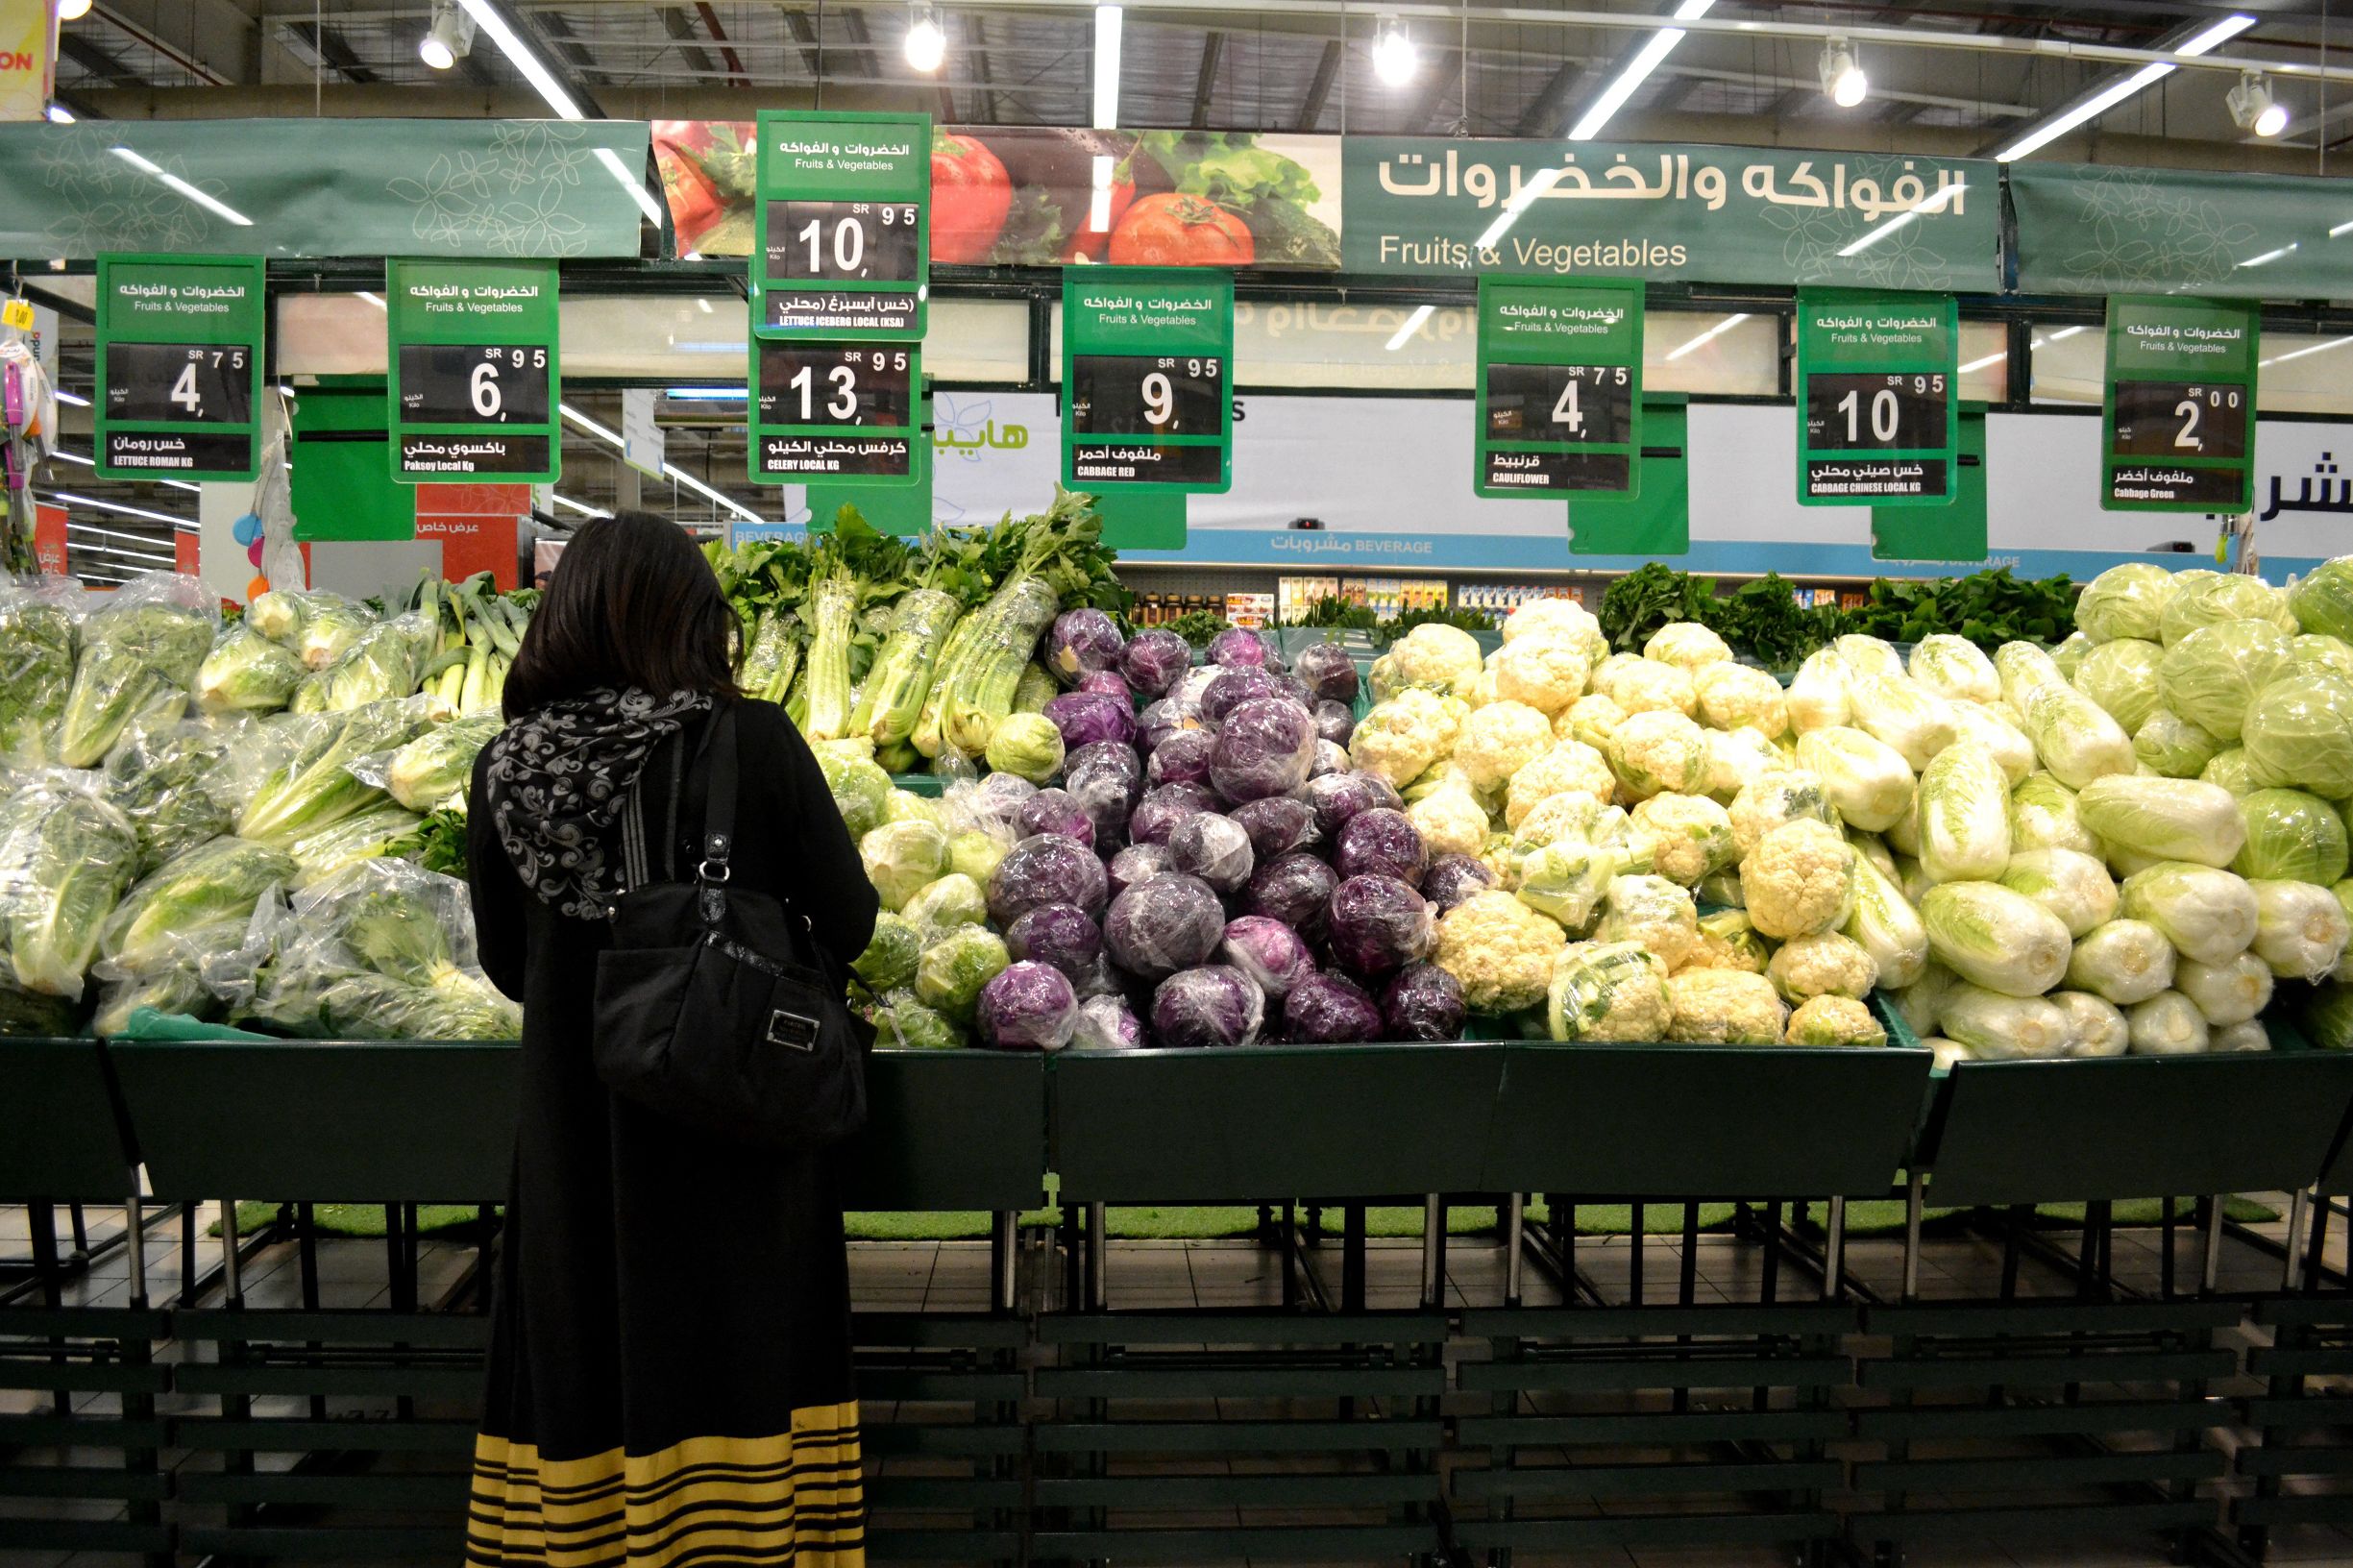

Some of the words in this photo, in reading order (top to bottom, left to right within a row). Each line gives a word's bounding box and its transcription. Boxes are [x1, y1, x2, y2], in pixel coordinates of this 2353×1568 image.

[780, 142, 828, 155] الفواكه
[832, 147, 839, 156] و
[846, 144, 909, 156] الخضروات
[796, 159, 823, 169] Fruits
[826, 160, 834, 169] &
[838, 159, 894, 171] Vegetables
[1379, 149, 1727, 210] والخضروات
[1742, 160, 1965, 222] الفواكه
[853, 204, 870, 214] SR
[1381, 235, 1467, 266] Fruits
[1480, 241, 1501, 266] &
[1513, 238, 1687, 273] Vegetables
[120, 284, 166, 296] الفواكه
[183, 286, 245, 298] الخضروات
[410, 284, 458, 298] الفواكه
[475, 286, 538, 299] الخضروات
[135, 301, 161, 311] Fruits
[165, 302, 171, 310] &
[176, 302, 230, 313] Vegetables
[1084, 296, 1132, 308] الفواكه
[1148, 299, 1212, 309] الخضروات
[426, 303, 453, 312] Fruits
[457, 304, 464, 312] &
[468, 303, 523, 314] Vegetables
[1500, 305, 1546, 317] الفواكه
[1550, 310, 1556, 319] و
[1562, 307, 1624, 320] الخضروات
[779, 316, 816, 326] LETTUCE
[817, 316, 851, 327] ICEBERG
[853, 317, 879, 327] LOCAL
[880, 317, 904, 328] (KSA)
[1099, 314, 1126, 324] Fruits
[1131, 315, 1138, 324] &
[1141, 315, 1196, 327] Vegetables
[1817, 315, 1862, 328] الفواكه
[1877, 317, 1936, 329] الخضروات
[1514, 322, 1541, 331] Fruits
[1555, 324, 1608, 334] Vegetables
[2127, 325, 2170, 336] الفواكه
[2184, 327, 2241, 338] الخضروات
[1831, 333, 1857, 342] Fruits
[1870, 333, 1922, 344] Vegetables
[2141, 341, 2165, 351] Fruits
[2169, 342, 2174, 351] &
[2177, 342, 2226, 353] Vegetables
[188, 351, 204, 359] SR
[485, 349, 502, 358] SR
[845, 353, 861, 361] SR
[1158, 358, 1174, 368] SR
[1568, 367, 1584, 376] SR
[1887, 376, 1902, 385] SR
[2189, 388, 2202, 397] SR
[1839, 390, 1899, 441] 10
[114, 436, 152, 451] رومان
[154, 438, 185, 450] خس
[769, 441, 811, 454] الكيلو
[815, 441, 855, 457] محلي
[859, 442, 906, 455] كرفس
[404, 442, 445, 458] محلي
[449, 442, 505, 458] باكسوي
[1078, 446, 1109, 461] أحمر
[1112, 447, 1162, 461] ملفوف
[114, 455, 148, 466] LETTUCE
[150, 456, 180, 467] ROMAN
[182, 457, 193, 467] KG
[404, 460, 436, 472] Paksoy
[437, 461, 461, 471] Local
[462, 461, 474, 472] Kg
[768, 459, 798, 470] CELERY
[799, 459, 825, 470] LOCAL
[827, 460, 839, 470] KG
[1493, 454, 1540, 469] قرنبيط
[1078, 466, 1116, 477] CABBAGE
[1118, 467, 1135, 477] RED
[1811, 465, 1850, 481] محلي
[1852, 465, 1891, 479] صيني
[1893, 465, 1923, 476] خس
[2115, 469, 2147, 482] أخضر
[1493, 473, 1549, 484] CAULIFLOWER
[2149, 472, 2194, 484] ملفوف
[1811, 482, 1849, 493] CABBAGE
[1850, 482, 1882, 493] CHINESE
[1884, 482, 1908, 492] LOCAL
[1909, 482, 1921, 492] KG
[2115, 487, 2148, 499] Cabbage
[2150, 489, 2174, 499] Green
[1271, 534, 1351, 552] مشروبات
[1355, 540, 1433, 554] BEVERAGE
